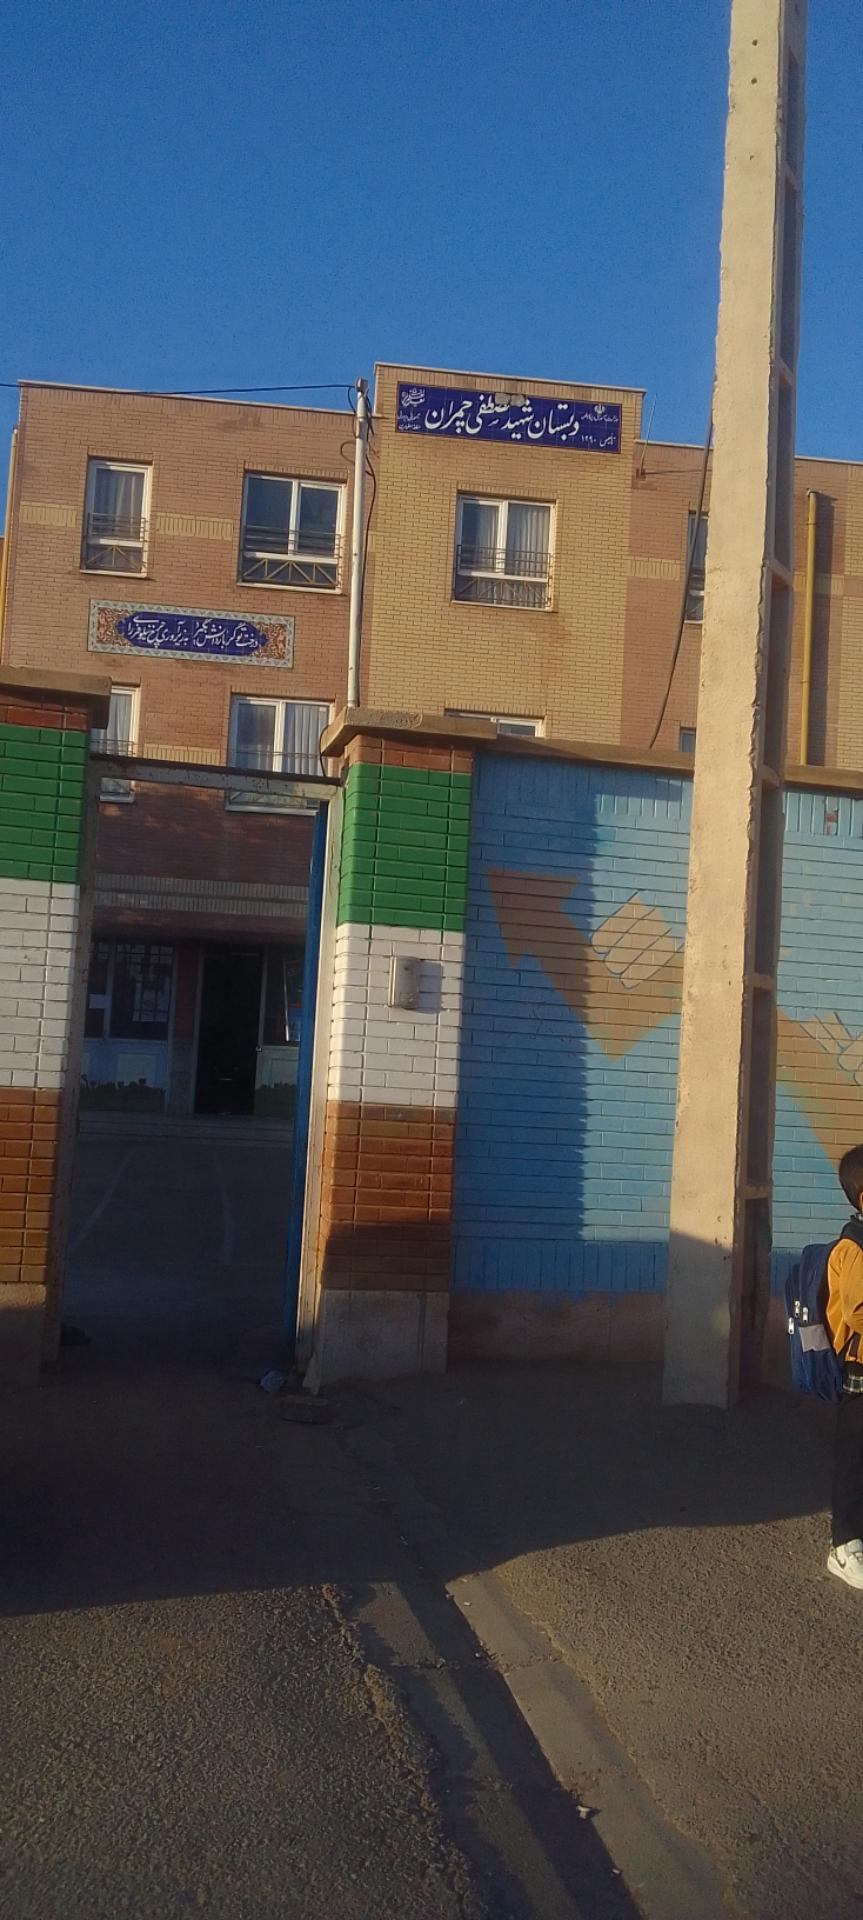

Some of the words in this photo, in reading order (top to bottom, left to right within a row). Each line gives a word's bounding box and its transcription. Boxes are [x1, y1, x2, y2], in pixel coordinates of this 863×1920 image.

[424, 399, 473, 434] چمران
[500, 399, 534, 439] شهید
[527, 403, 579, 440] دبستان
[196, 623, 227, 647] دانش
[225, 622, 246, 646] گر
[235, 632, 259, 648] درخت
